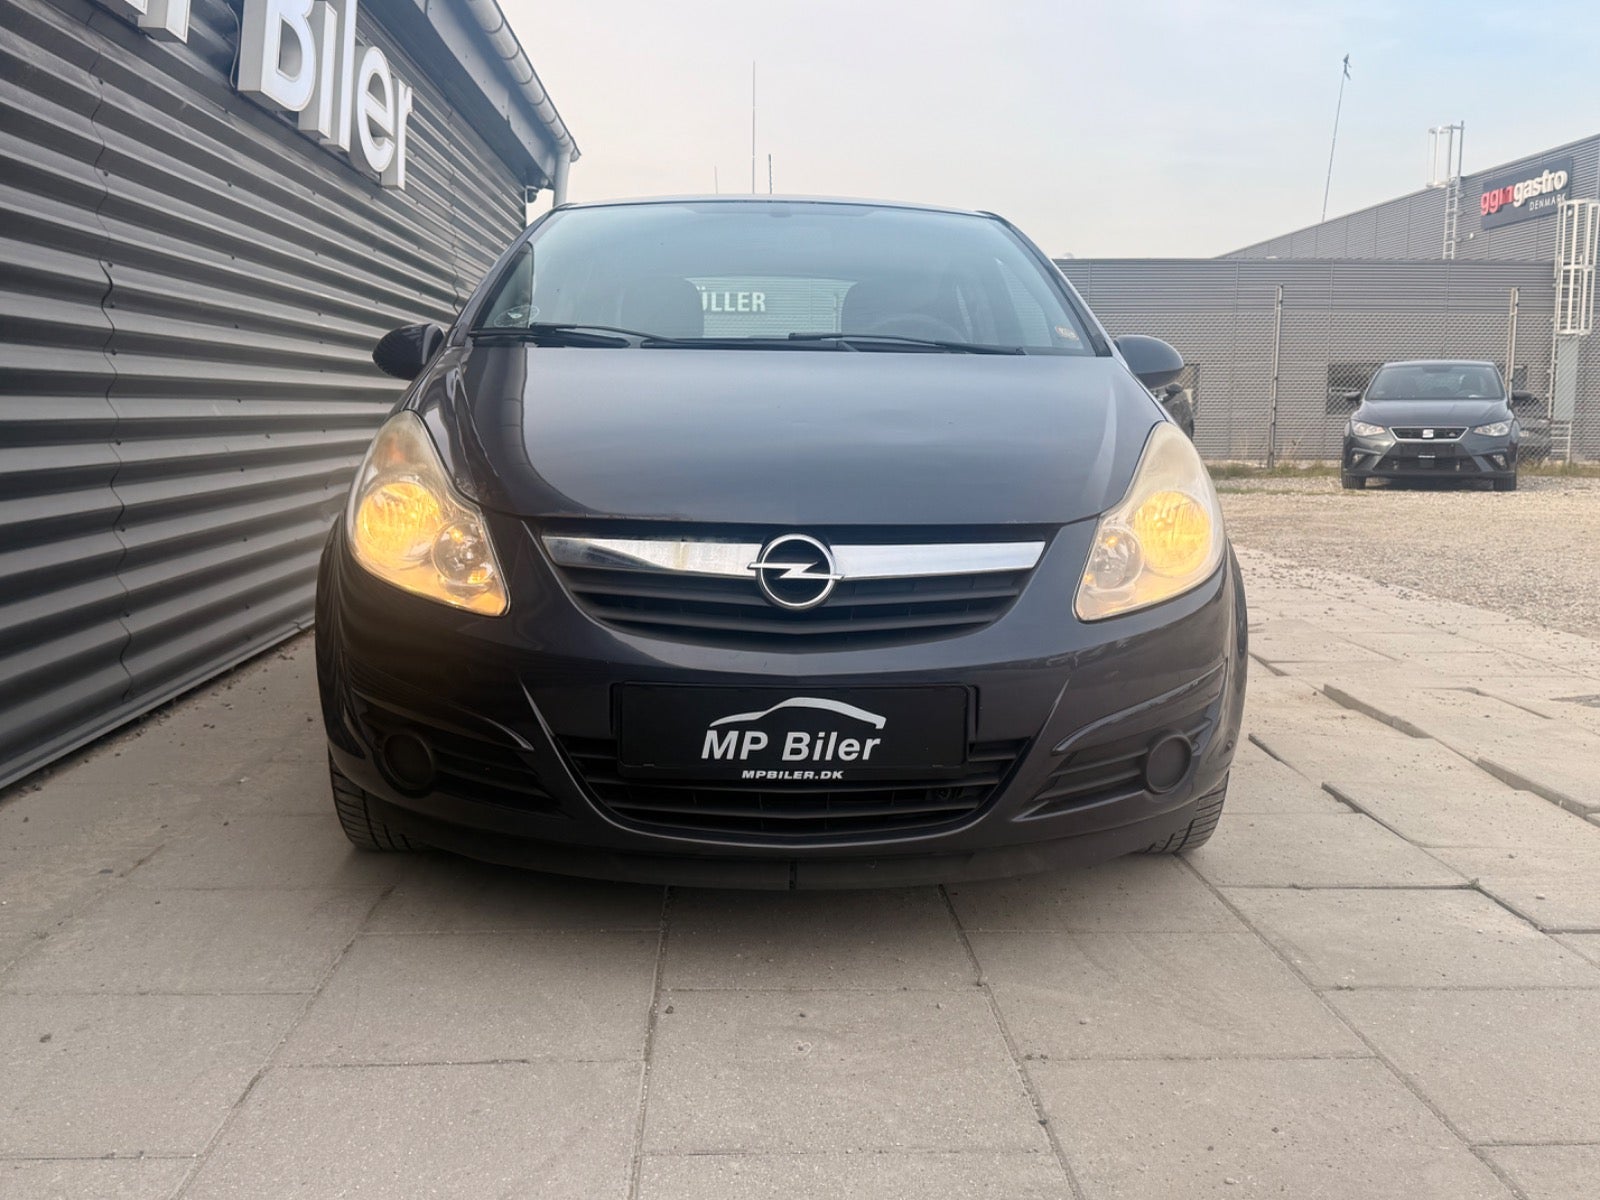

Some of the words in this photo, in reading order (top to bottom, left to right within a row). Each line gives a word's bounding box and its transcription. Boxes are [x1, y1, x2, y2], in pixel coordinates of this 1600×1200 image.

[701, 730, 768, 760] MP
[782, 731, 881, 761] Biler
[741, 769, 844, 780] MPBILER.DK
